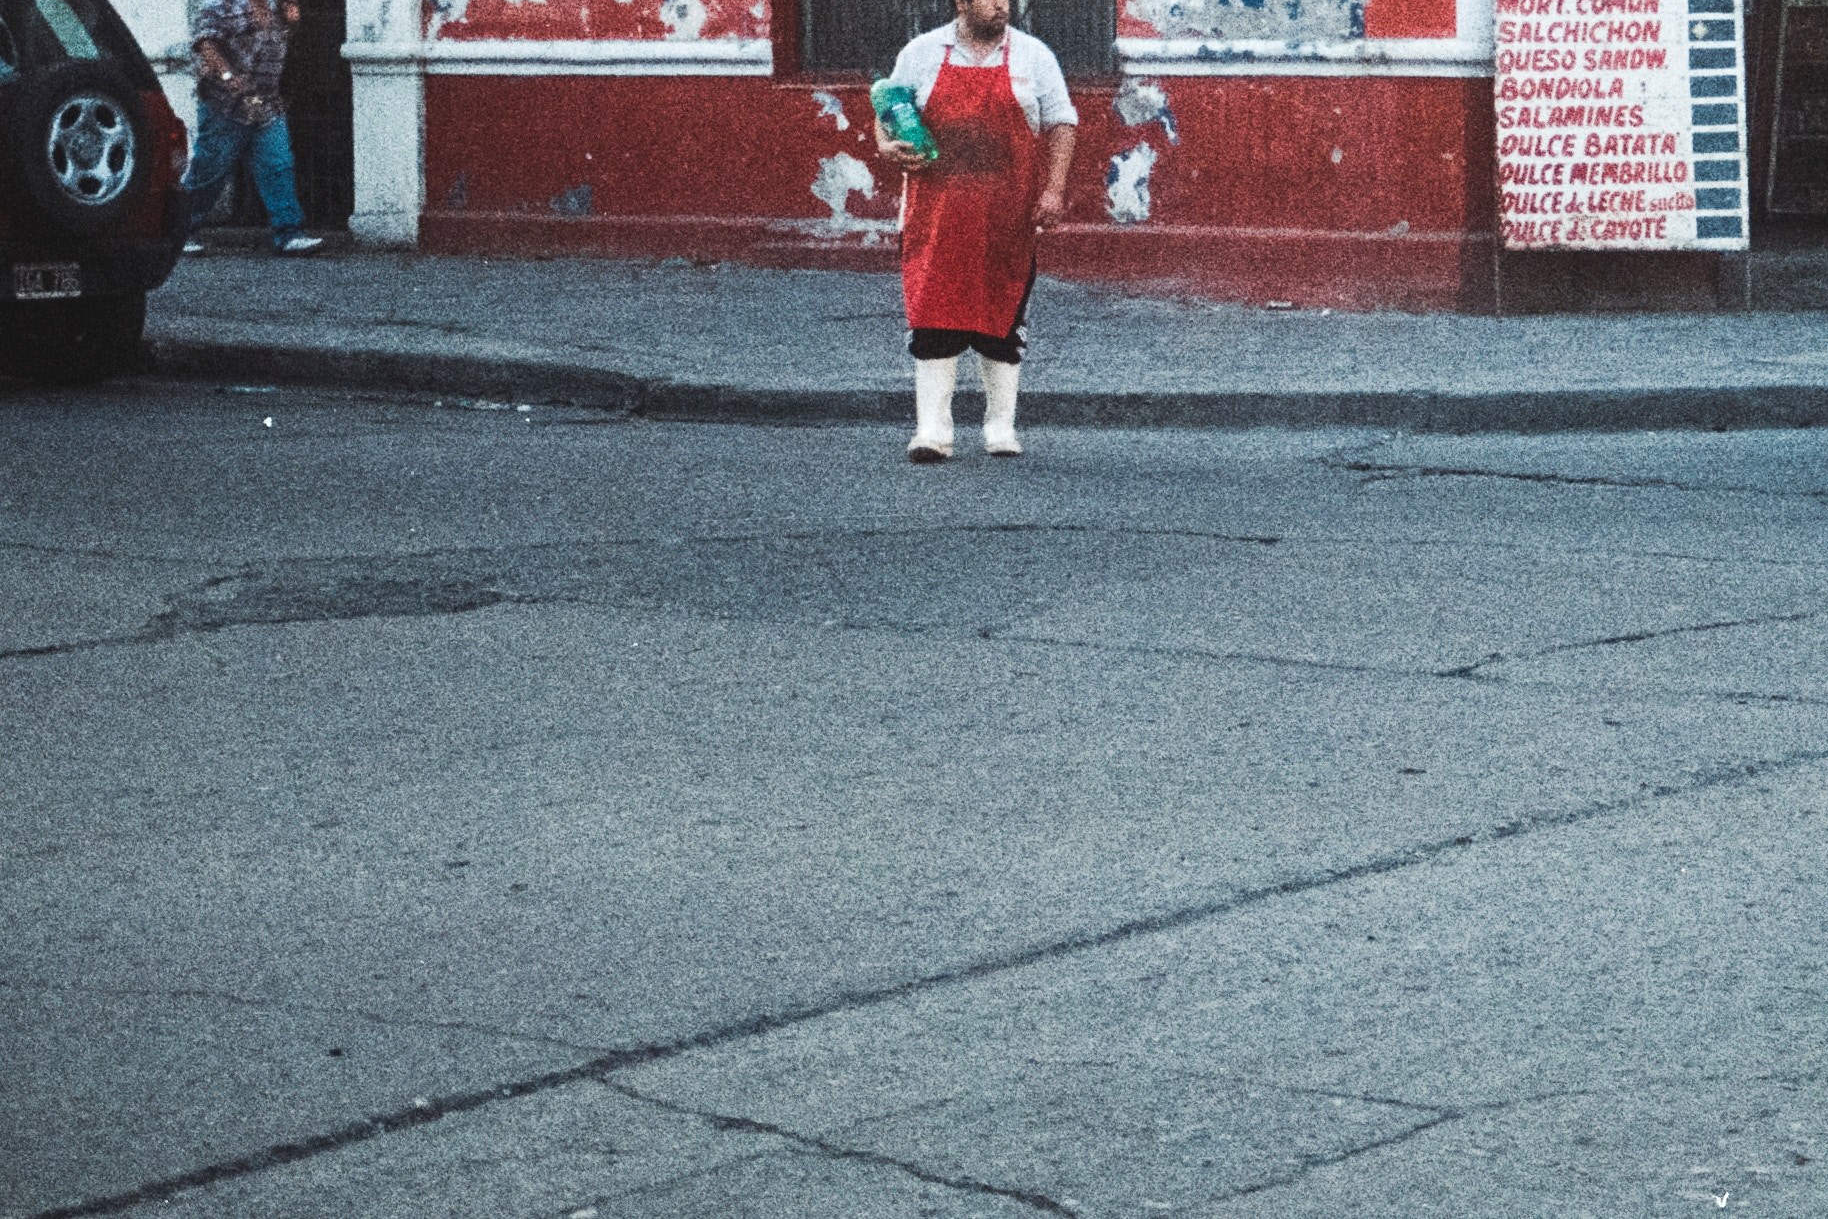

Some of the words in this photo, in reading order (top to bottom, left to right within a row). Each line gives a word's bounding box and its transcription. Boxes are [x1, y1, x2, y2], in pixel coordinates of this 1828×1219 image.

[1498, 20, 1662, 44] SALCHICHON
[1497, 47, 1577, 75] QUESO
[1498, 76, 1624, 102] BONDIOLA
[1498, 104, 1644, 130] SALAMINES
[1499, 133, 1575, 158] DULCE
[1583, 132, 1676, 158] BATATA
[1499, 162, 1563, 186] DULCE
[1569, 160, 1688, 186] MEMBRILLO
[1500, 191, 1562, 215] DULCE
[1587, 189, 1644, 214] LECHE
[1500, 218, 1561, 245] DULCE
